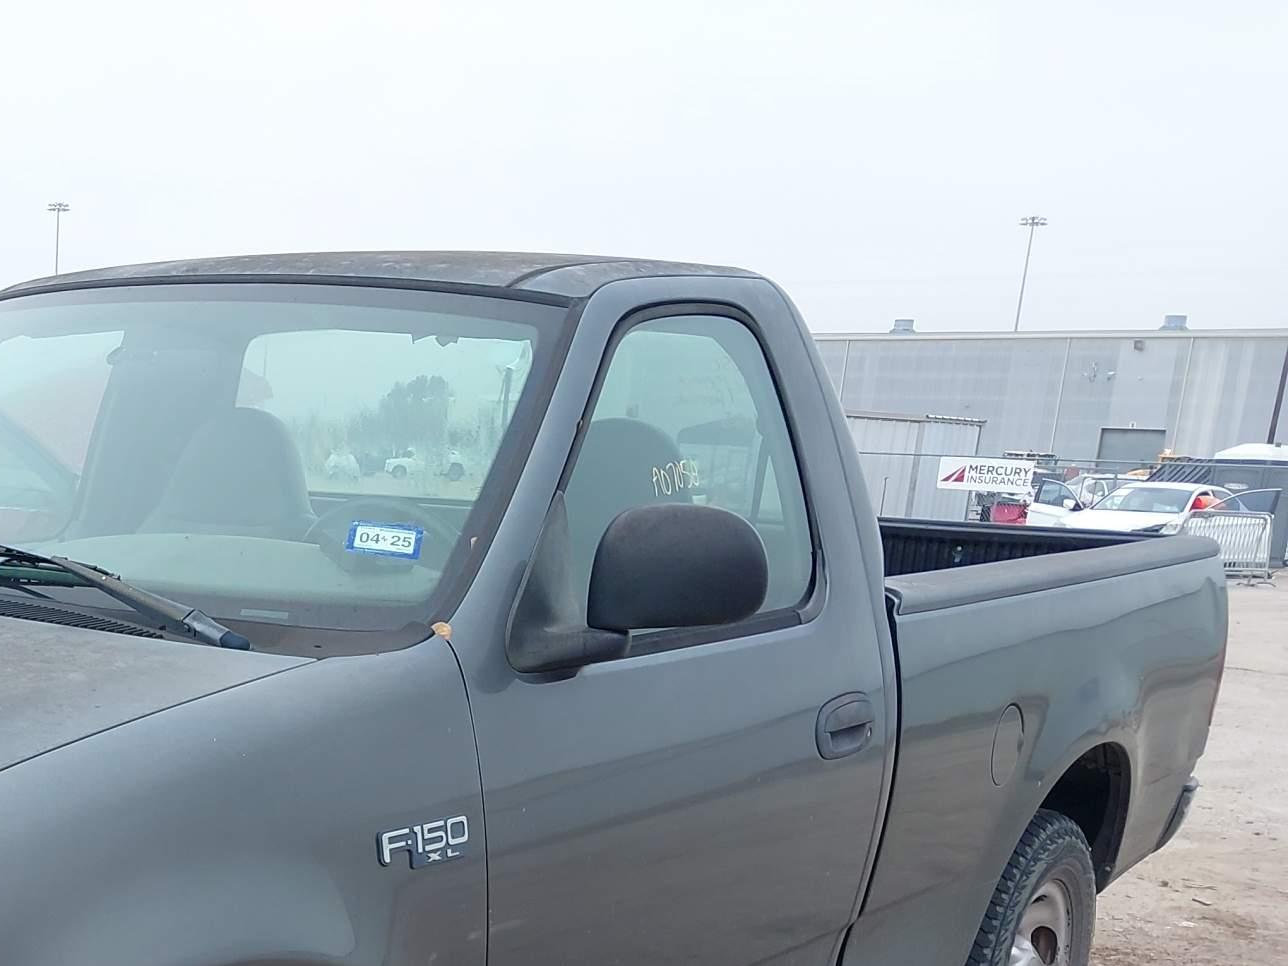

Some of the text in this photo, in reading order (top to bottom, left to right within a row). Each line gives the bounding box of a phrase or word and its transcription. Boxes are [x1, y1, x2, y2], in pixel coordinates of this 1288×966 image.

[967, 464, 1031, 478] MERCURY
[966, 475, 1030, 487] INSURANCE
[359, 531, 413, 548] 04 25
[426, 848, 461, 863] XL
